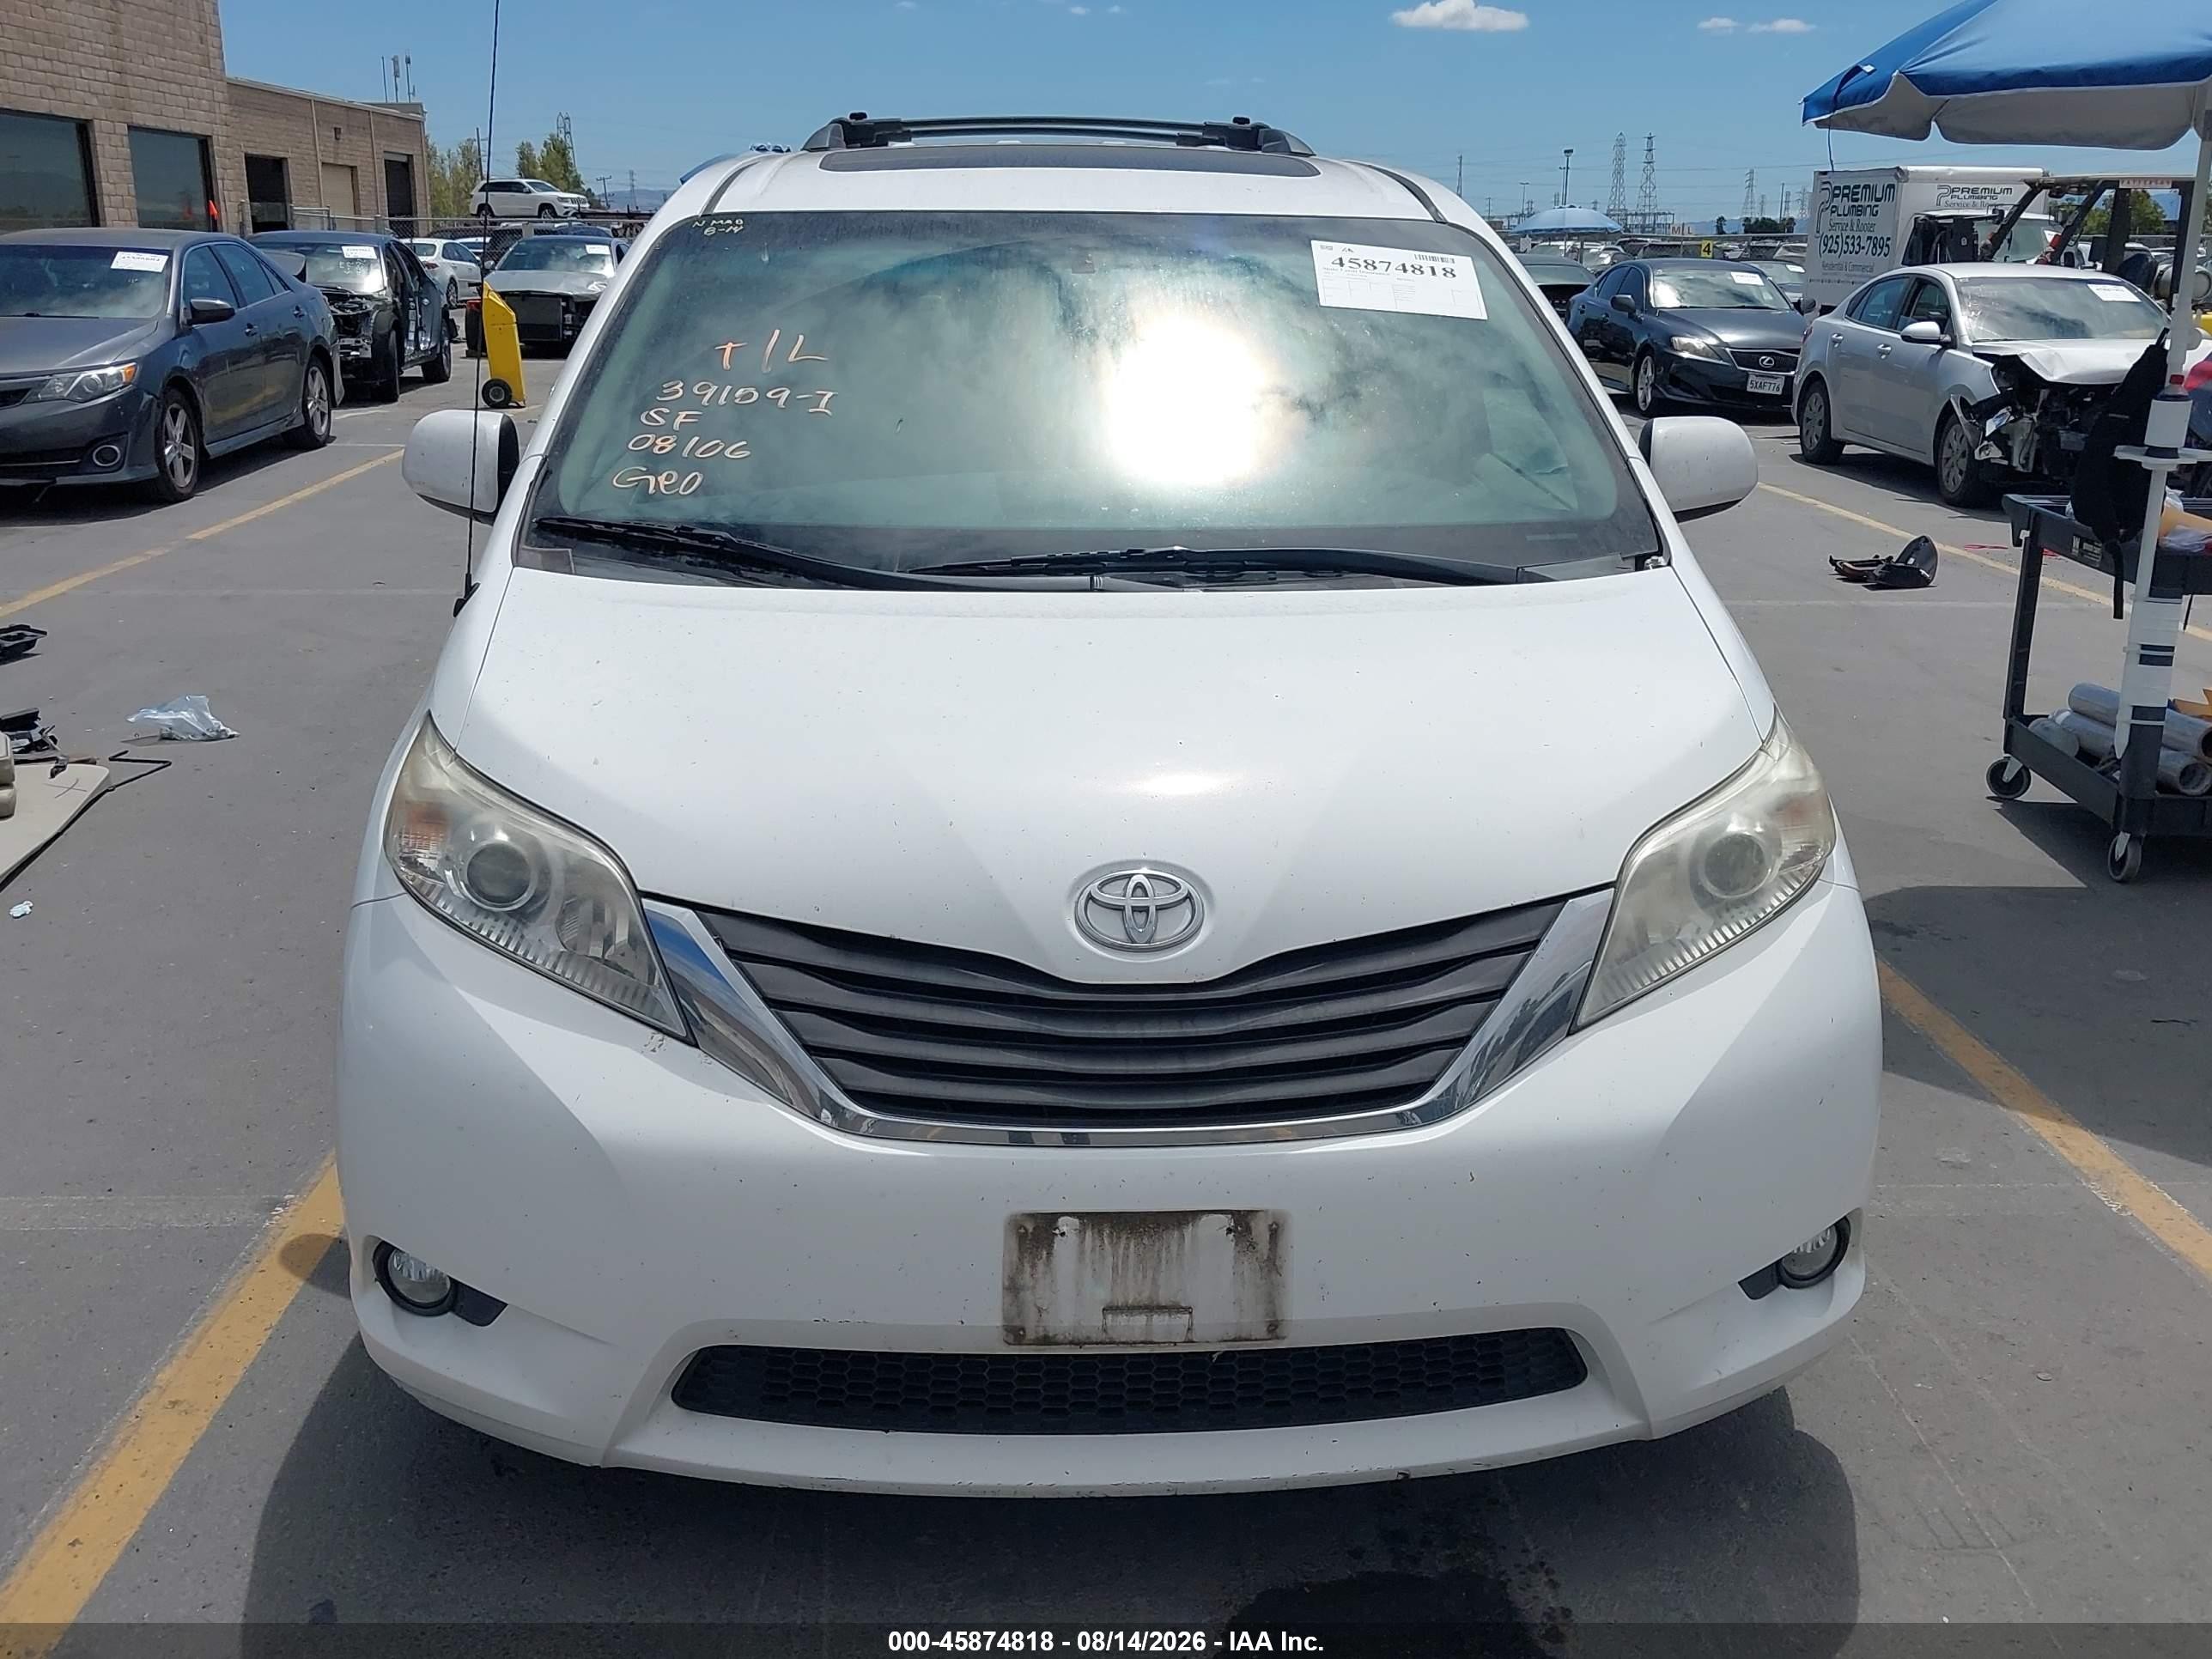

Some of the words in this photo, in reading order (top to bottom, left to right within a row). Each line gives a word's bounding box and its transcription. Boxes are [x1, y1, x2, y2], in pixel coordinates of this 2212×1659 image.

[1832, 184, 1896, 203] PREMIUM
[1951, 186, 2013, 195] PREMIUM
[1830, 204, 1880, 217] PLUMBING
[1828, 218, 1848, 232] Service
[1855, 218, 1876, 233] Rooter
[1702, 242, 1711, 256] 4
[1819, 232, 1891, 258] (925)533-7895
[1331, 256, 1457, 279] 45874818
[1749, 380, 1782, 392] 5XAF776
